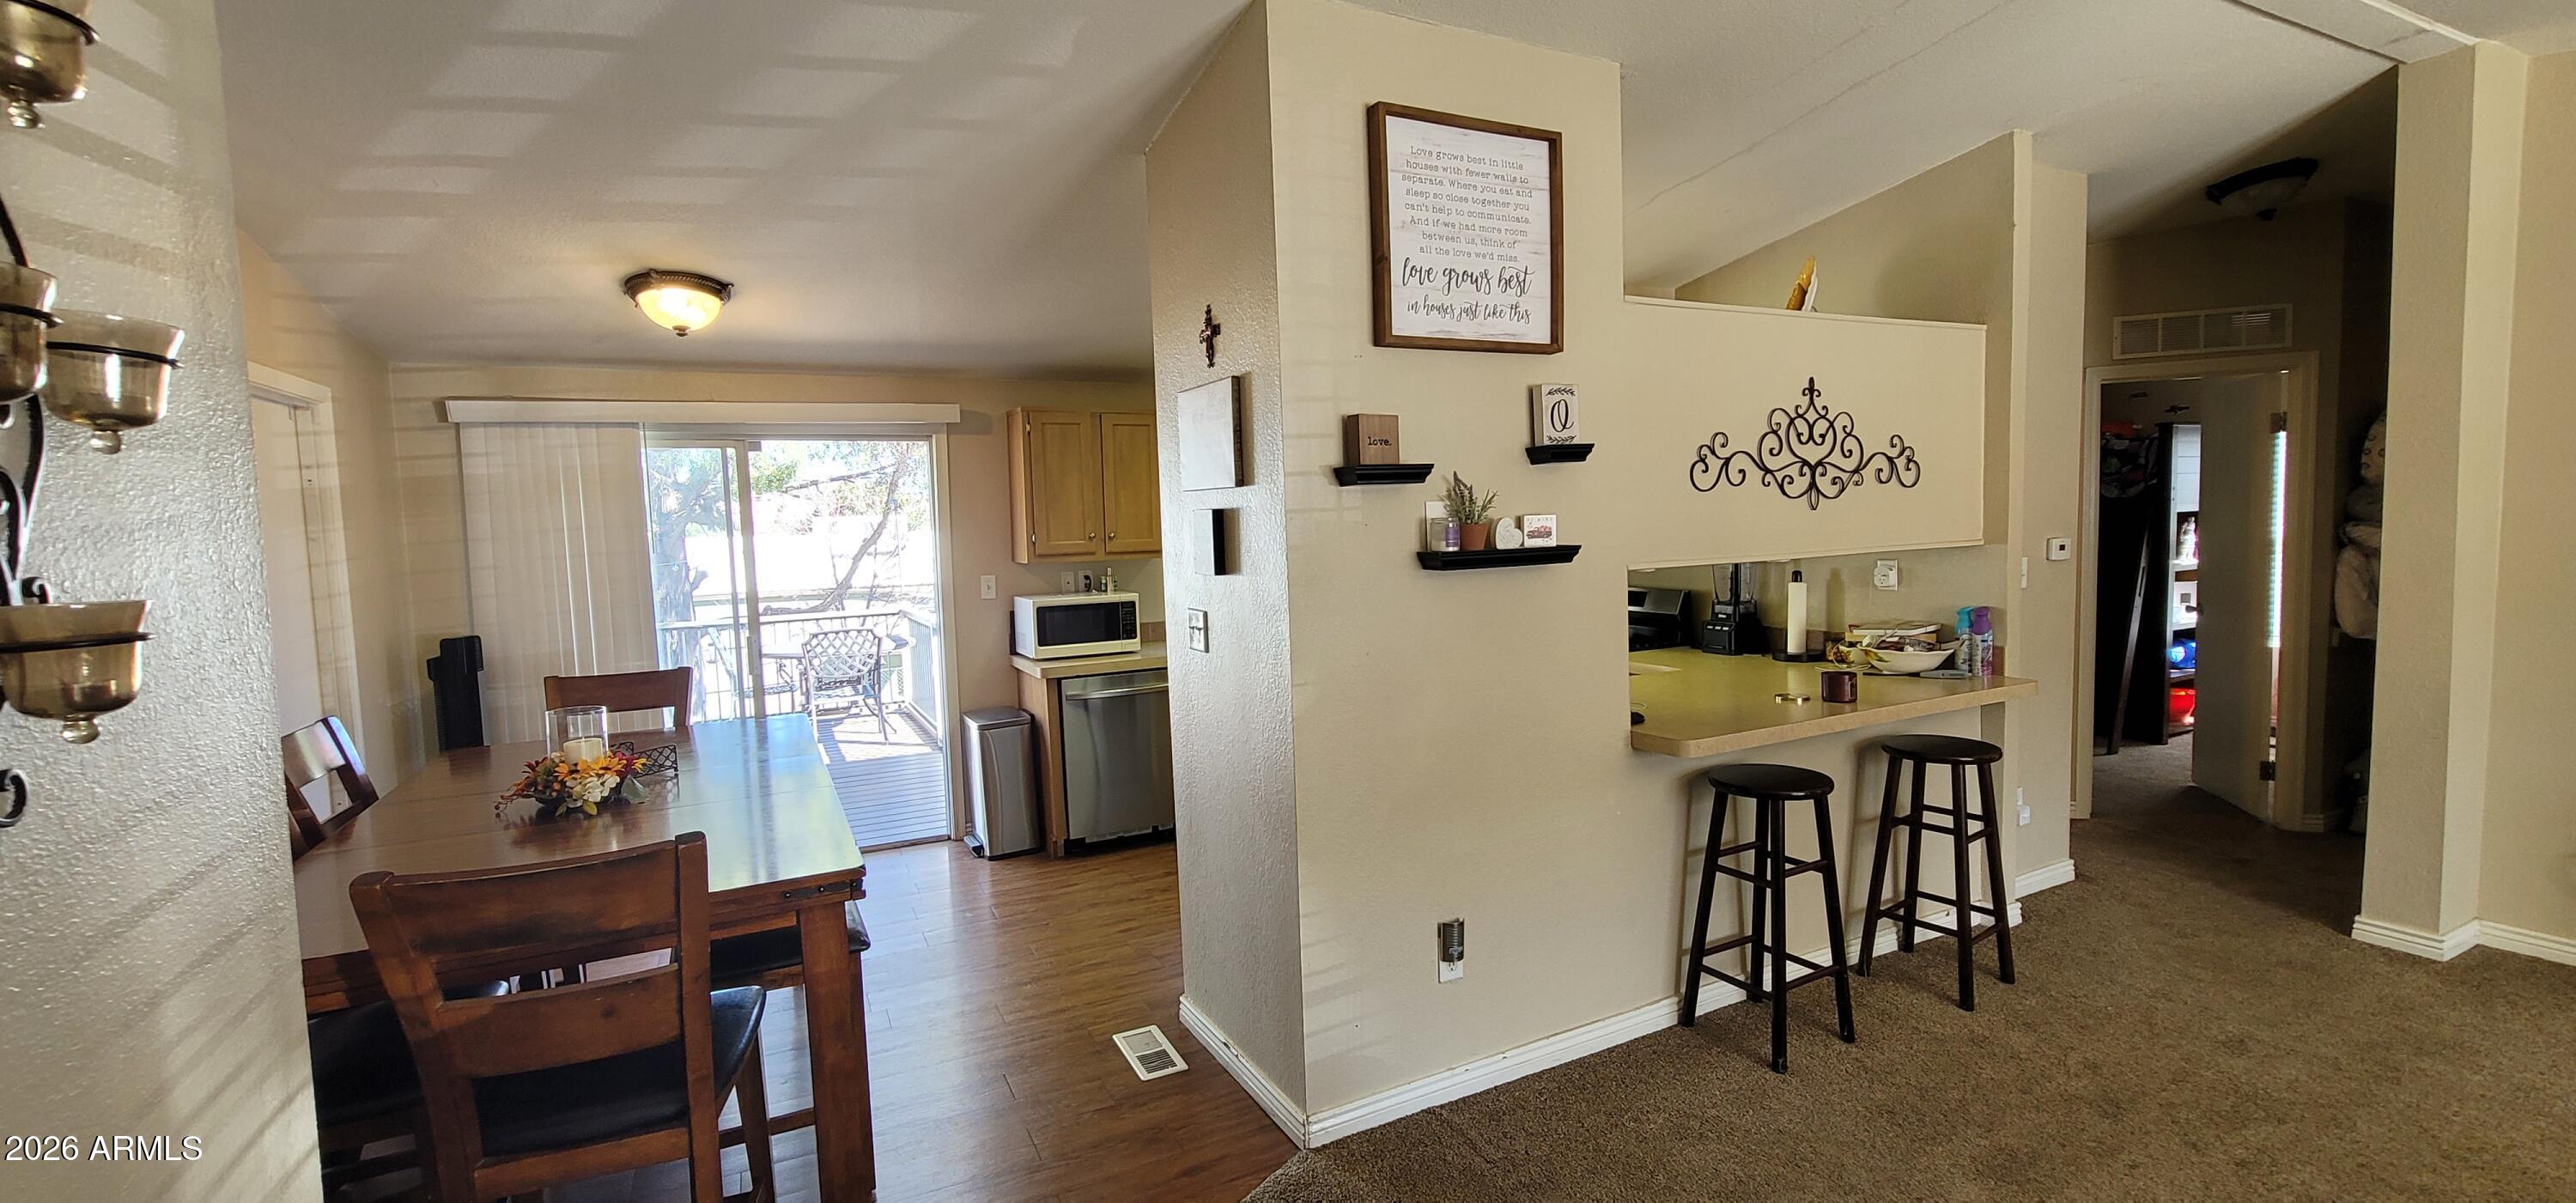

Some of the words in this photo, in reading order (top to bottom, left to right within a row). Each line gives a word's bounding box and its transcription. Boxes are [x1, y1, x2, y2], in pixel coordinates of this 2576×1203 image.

[1411, 146, 1433, 157] Love
[1436, 151, 1464, 161] grows
[1467, 155, 1486, 165] best
[1489, 158, 1498, 167] in
[1501, 159, 1523, 170] little
[1406, 159, 1438, 172] houses
[1442, 166, 1462, 175] with
[1465, 167, 1491, 179] fewer
[1493, 173, 1517, 182] walls
[1401, 174, 1446, 186] separate.
[1449, 179, 1478, 191] Where
[1480, 185, 1497, 193] you
[1516, 189, 1532, 197] and
[1406, 188, 1431, 200] sleep
[1445, 193, 1468, 203] close
[1472, 197, 1511, 208] together
[1513, 203, 1529, 211] you
[1404, 203, 1429, 212] can't
[1432, 204, 1452, 216] help
[1455, 208, 1464, 216] to
[1467, 210, 1532, 224] communicate.
[1409, 216, 1429, 226] And
[1432, 218, 1440, 227] if
[1459, 222, 1476, 231] had
[1479, 225, 1502, 234] more
[1504, 228, 1528, 237] room
[1422, 231, 1461, 243] between
[1465, 237, 1478, 246] us,
[1480, 237, 1504, 248] think
[1507, 240, 1517, 249] of
[1419, 246, 1432, 254] all
[1435, 246, 1450, 256] the
[1453, 247, 1472, 258] love
[1474, 251, 1494, 260] we'd
[1497, 254, 1520, 263] miss.
[1402, 257, 1438, 286] love
[1442, 267, 1494, 296] grows
[1498, 265, 1535, 297] best
[1407, 301, 1421, 314] in
[1423, 294, 1456, 319] houses
[1456, 301, 1484, 322] just
[1484, 303, 1507, 320] like
[1499, 301, 1532, 325] this
[1367, 436, 1393, 447] love.
